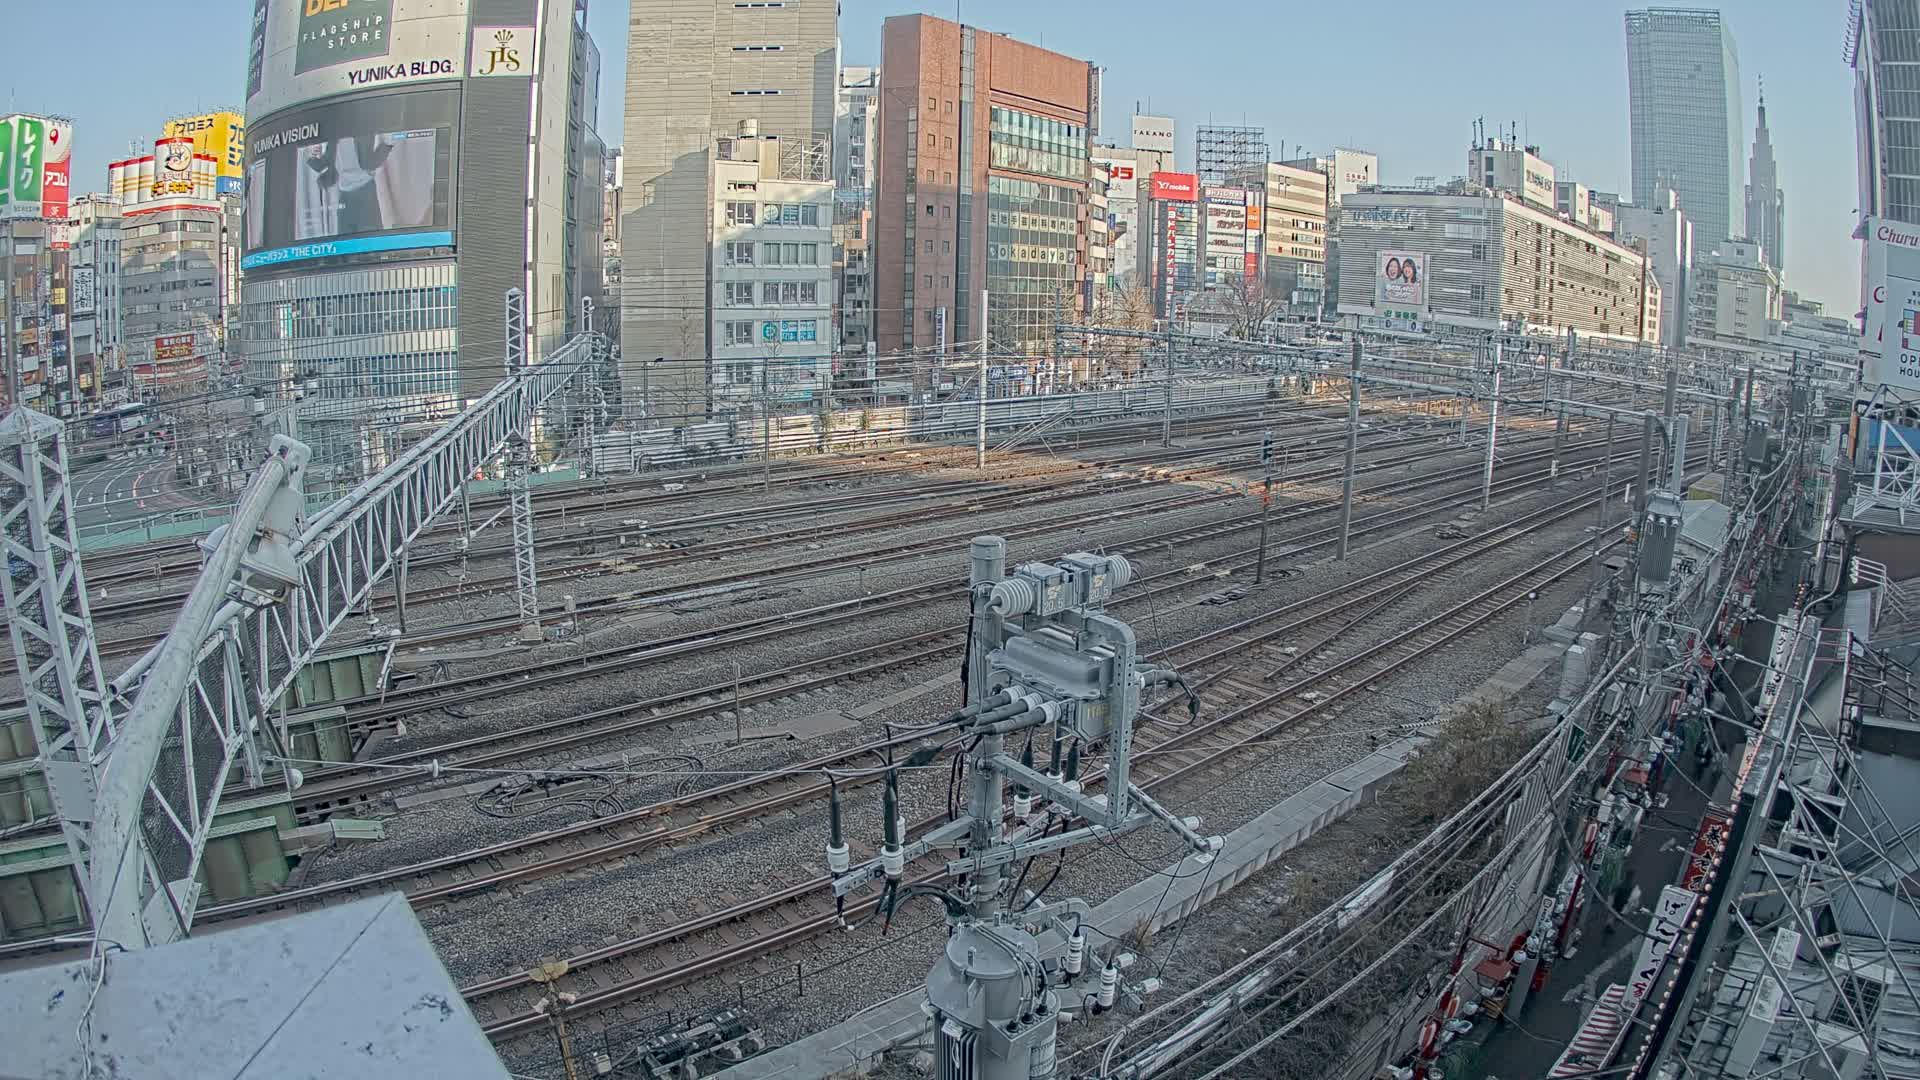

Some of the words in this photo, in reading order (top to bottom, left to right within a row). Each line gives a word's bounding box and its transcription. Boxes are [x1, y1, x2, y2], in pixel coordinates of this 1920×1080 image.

[303, 15, 384, 42] FLAGSHIP
[328, 30, 382, 49] STORE
[348, 65, 407, 86] YUNIKA
[410, 60, 456, 78] BLDG.
[282, 122, 320, 145] VISION
[20, 122, 37, 190] レイク
[45, 171, 68, 187] アコム
[1000, 246, 1065, 264] okadaya
